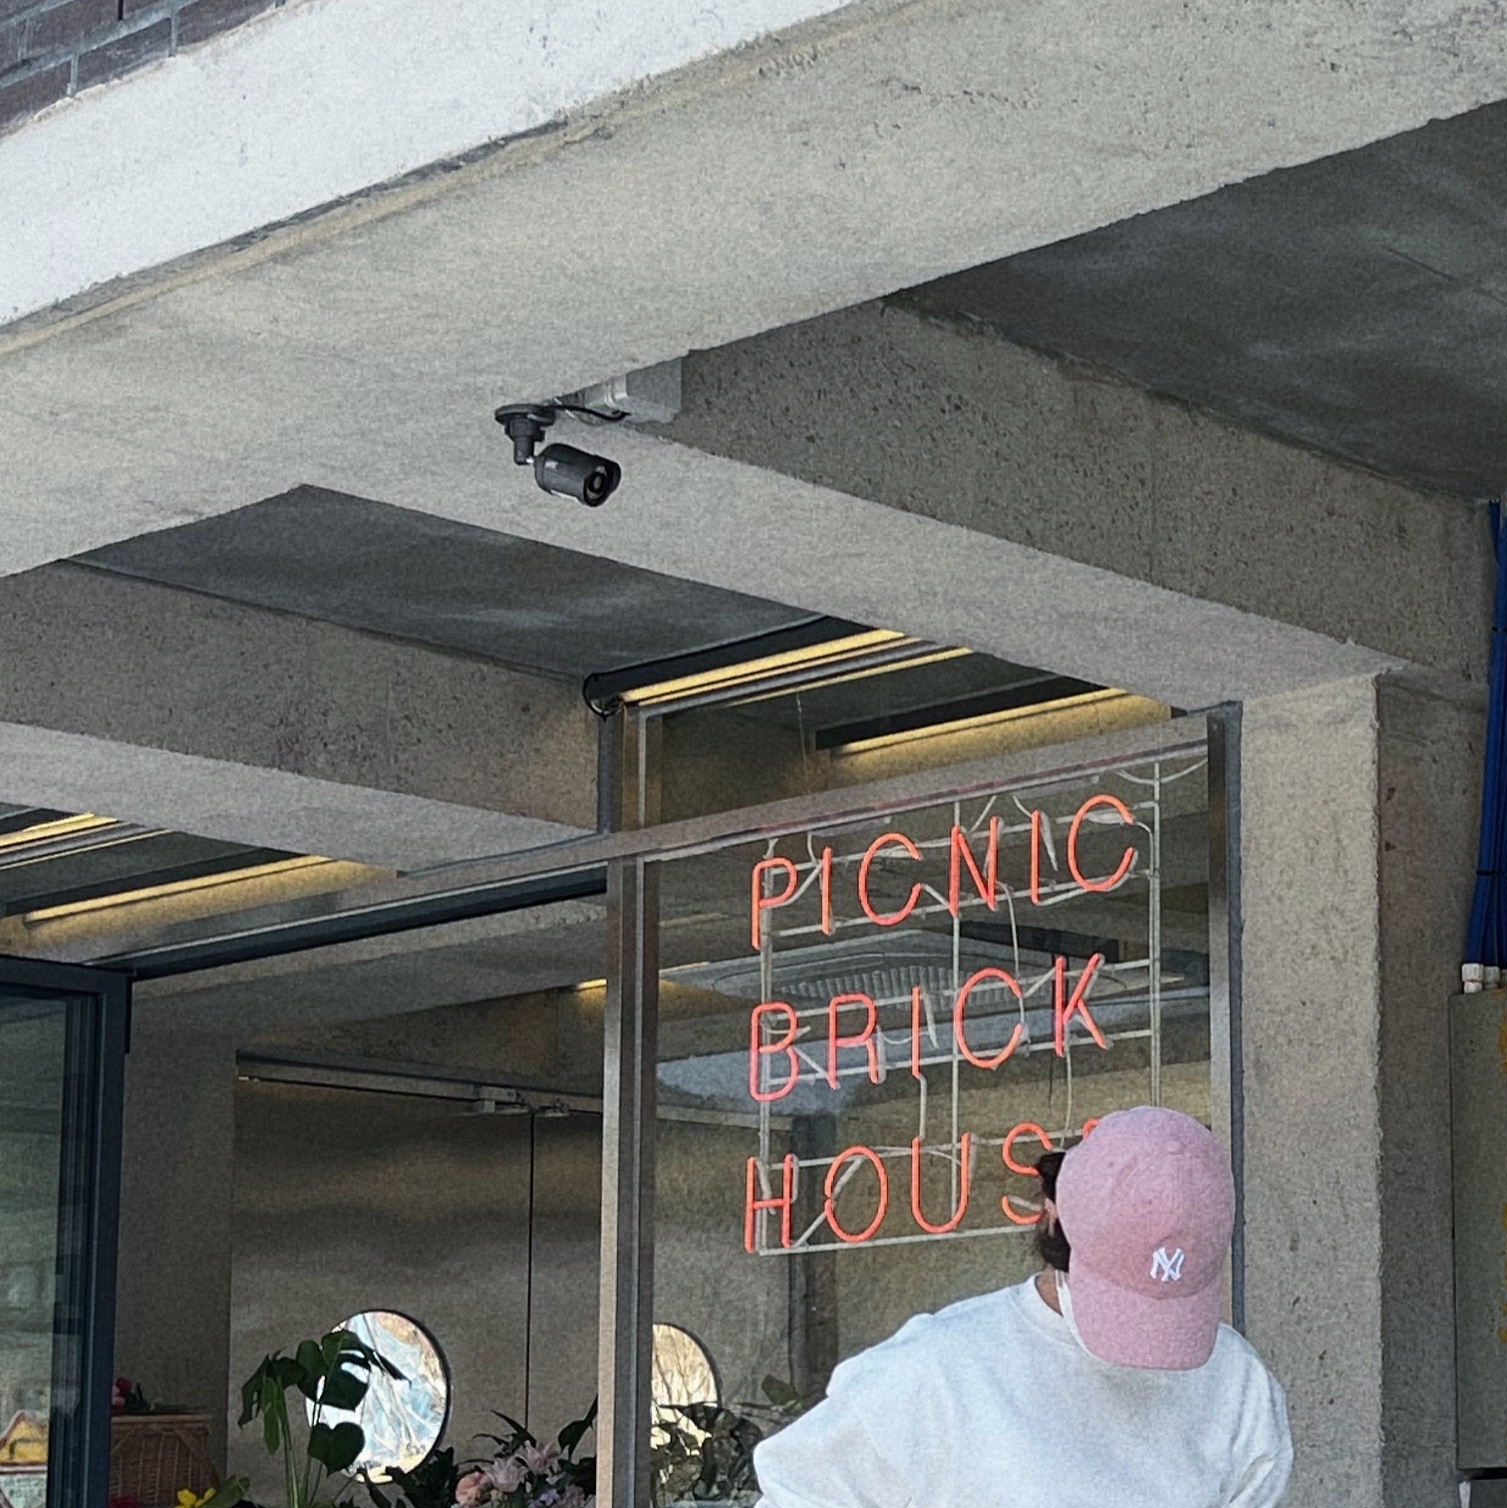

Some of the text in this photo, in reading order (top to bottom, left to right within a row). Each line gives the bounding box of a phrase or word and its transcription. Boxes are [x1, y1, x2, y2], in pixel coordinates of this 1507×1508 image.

[751, 794, 1135, 949] PICNIC
[749, 953, 1106, 1102] BRICK
[745, 1119, 1100, 1254] HOUS
[1150, 1247, 1185, 1281] NY
